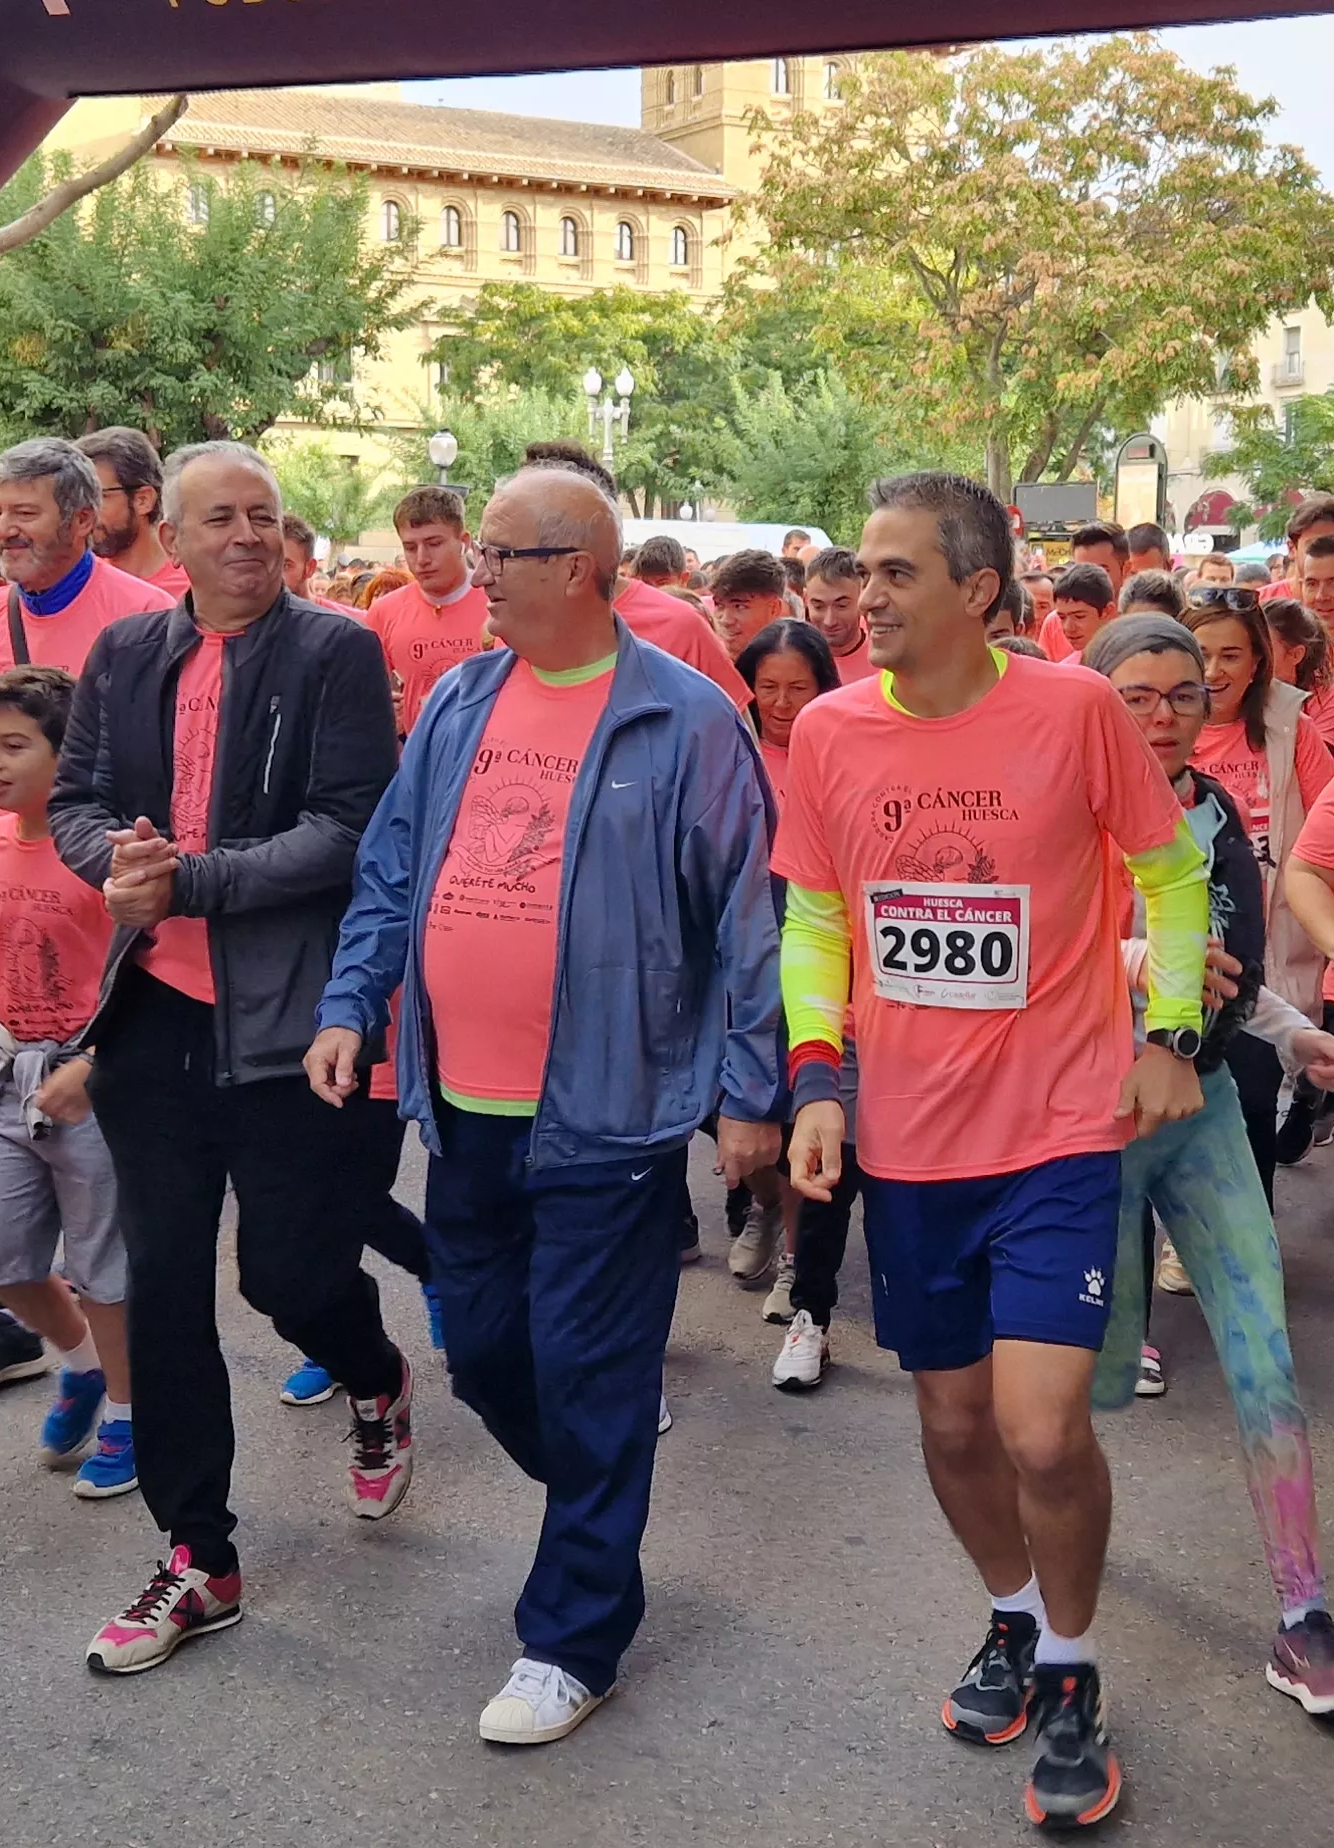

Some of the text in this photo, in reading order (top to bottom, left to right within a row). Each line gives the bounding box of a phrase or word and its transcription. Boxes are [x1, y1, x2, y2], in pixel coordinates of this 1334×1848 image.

[507, 748, 579, 773] CÁNCER
[540, 770, 576, 784] HUES
[918, 787, 1002, 810] CÁNCER
[962, 809, 1019, 821] HUESCA
[923, 897, 963, 908] HUESCA
[880, 905, 1012, 923] CONTRA EL CÁNCER
[879, 926, 1013, 977] 2980
